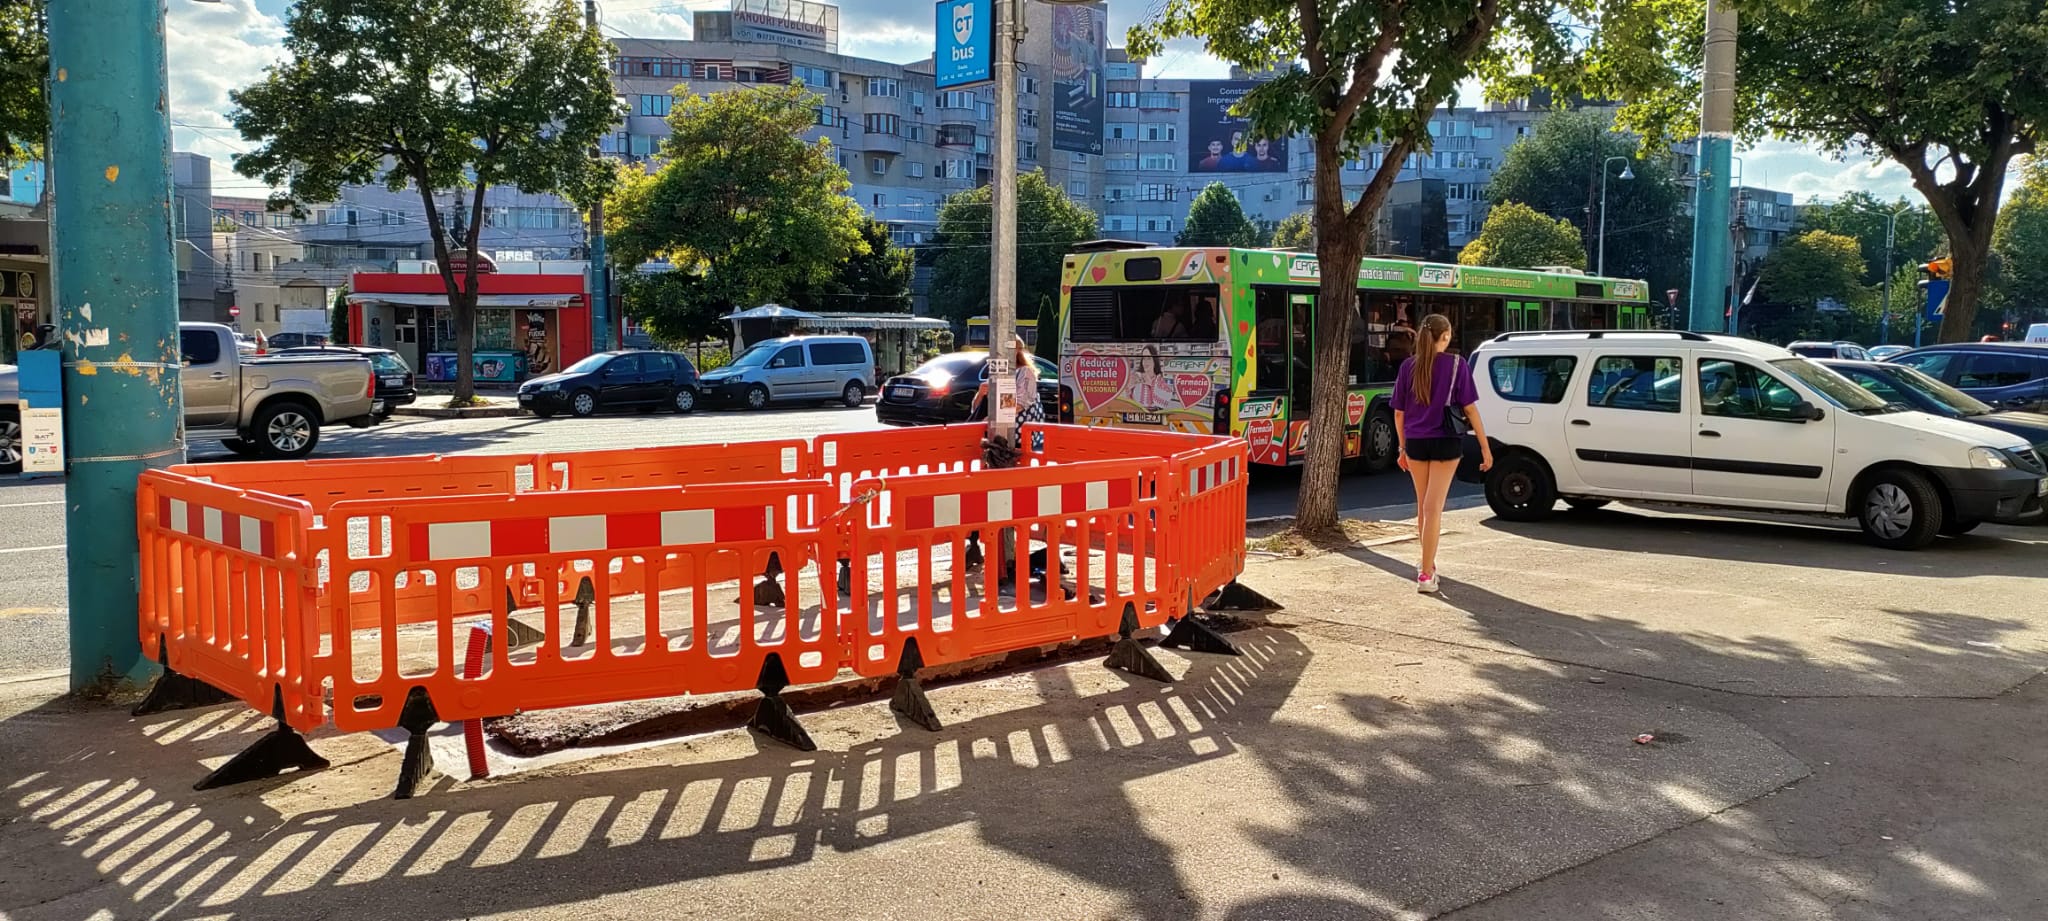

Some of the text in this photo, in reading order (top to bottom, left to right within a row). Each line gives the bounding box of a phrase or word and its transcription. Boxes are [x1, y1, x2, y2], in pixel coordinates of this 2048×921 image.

[734, 9, 774, 26] PANOURI
[955, 15, 972, 32] CT
[951, 45, 975, 61] bus
[1080, 357, 1118, 368] Reduceri
[1169, 360, 1206, 369] CATENA
[1080, 367, 1118, 379] speciale
[1176, 377, 1208, 386] Farmacia
[1181, 388, 1202, 396] inimii
[1243, 402, 1272, 414] CATENA
[1249, 424, 1272, 434] Farmacia
